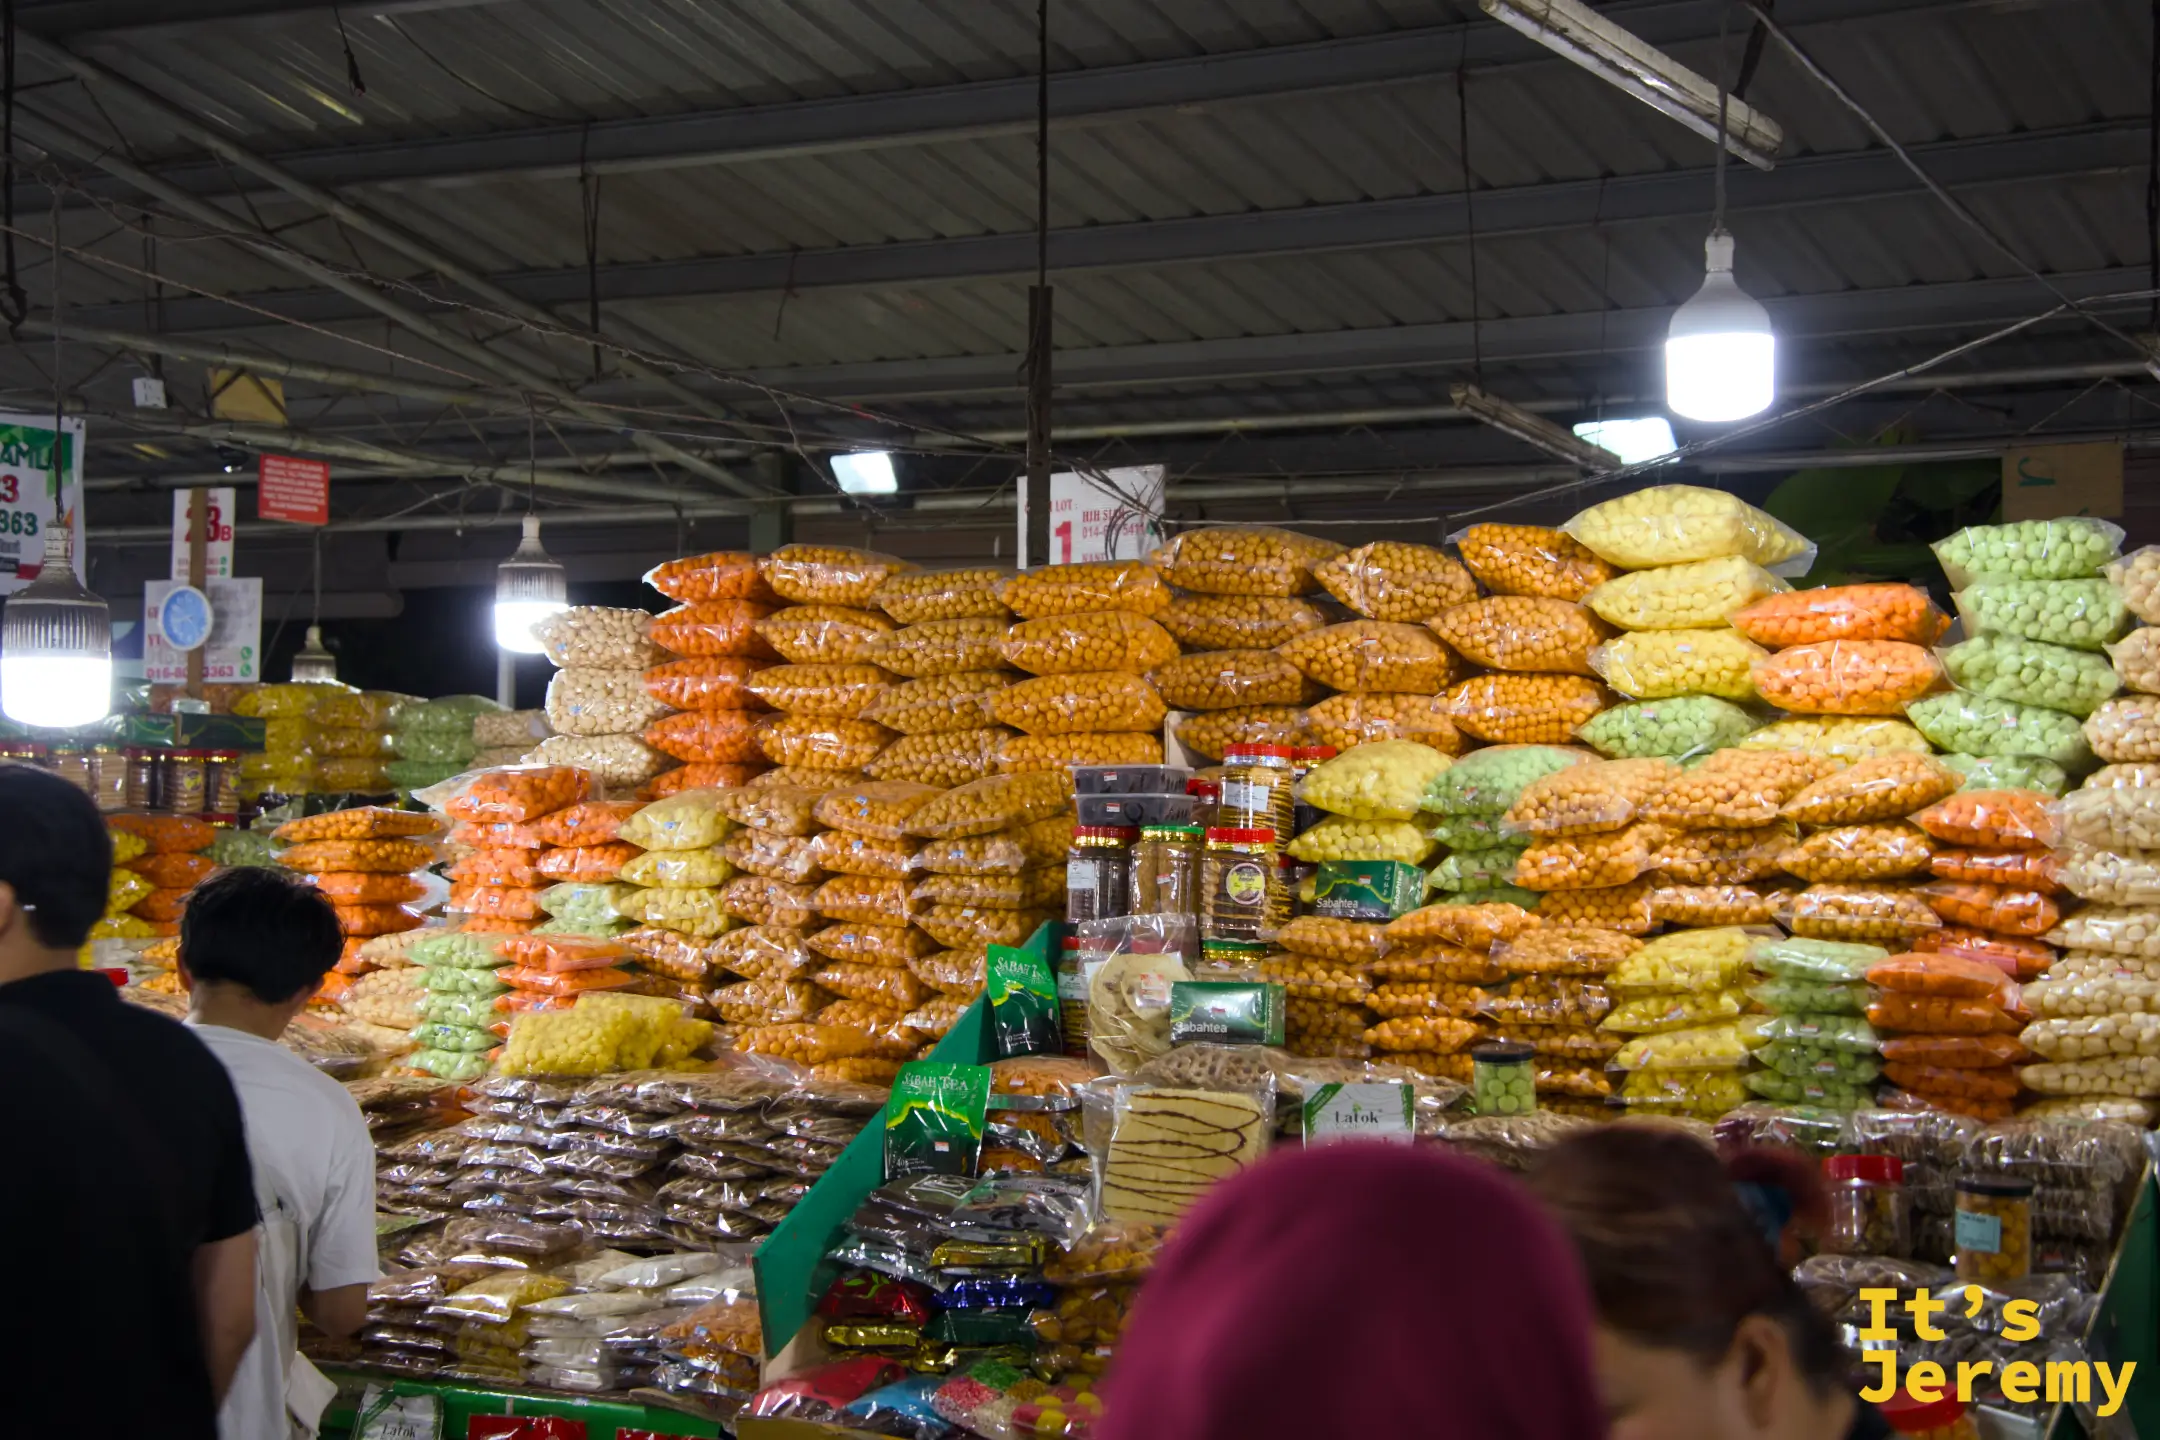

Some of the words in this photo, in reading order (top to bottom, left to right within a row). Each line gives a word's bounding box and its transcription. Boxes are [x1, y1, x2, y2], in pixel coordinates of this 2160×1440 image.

[1316, 897, 1359, 909] Sabahtea
[1175, 1021, 1228, 1034] Sabahtea
[902, 1072, 937, 1087] SABAH
[939, 1076, 968, 1091] TEA
